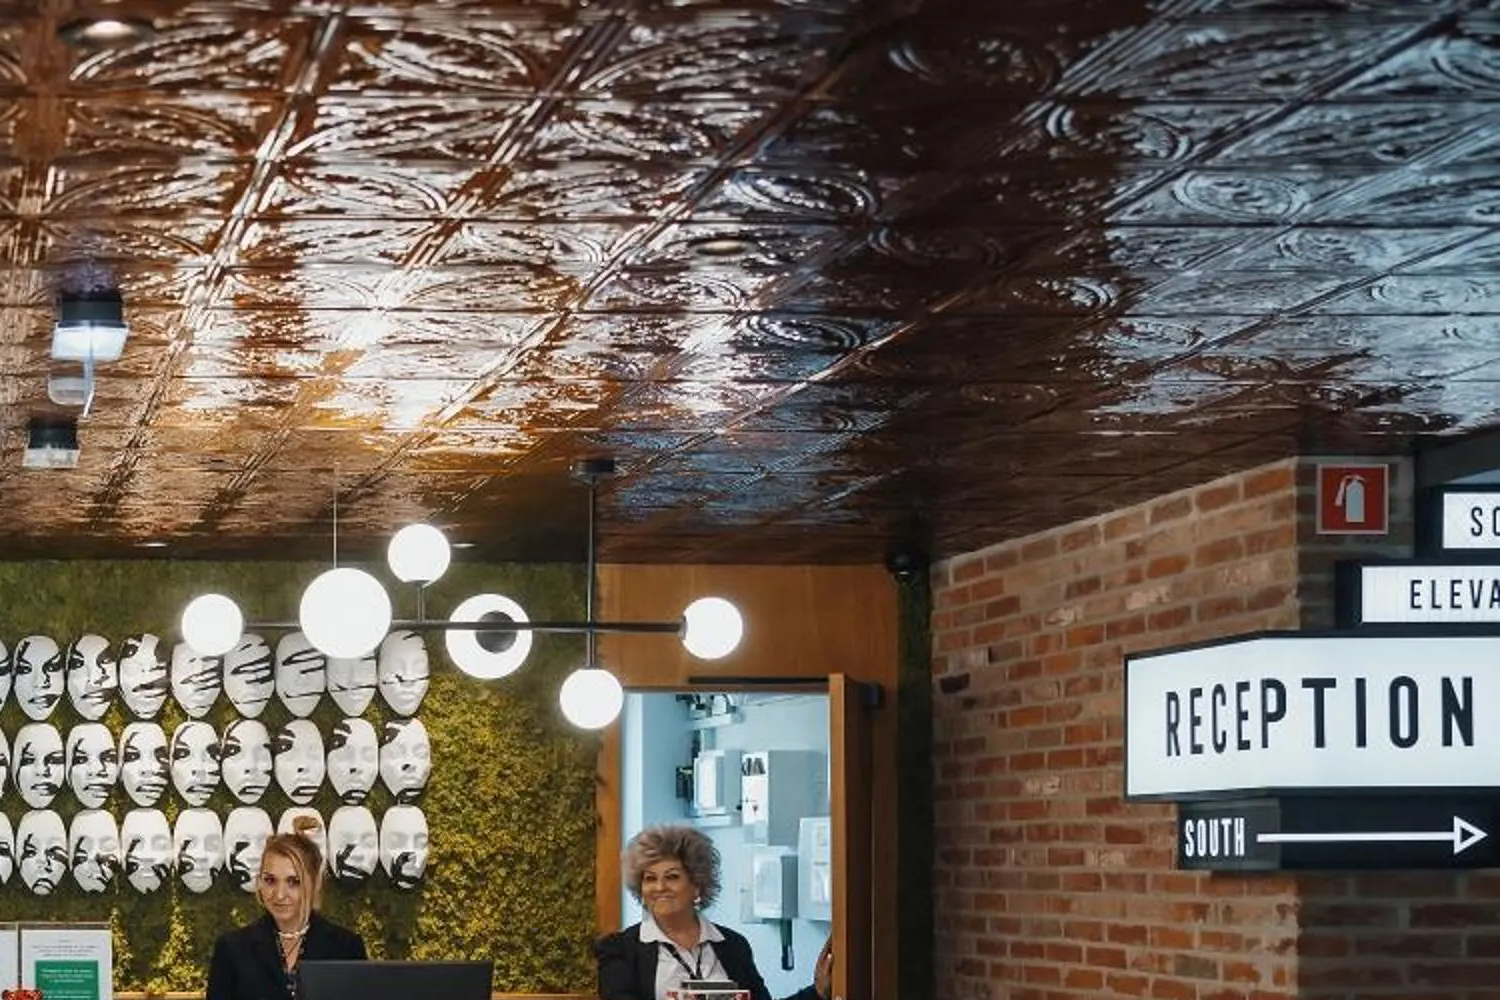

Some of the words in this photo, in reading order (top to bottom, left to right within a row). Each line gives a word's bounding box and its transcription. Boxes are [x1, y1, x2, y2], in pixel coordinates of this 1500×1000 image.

[1470, 506, 1500, 537] SO
[1410, 579, 1500, 610] ELEVA
[1165, 675, 1474, 757] RECEPTION
[1184, 817, 1246, 857] SOUTH
